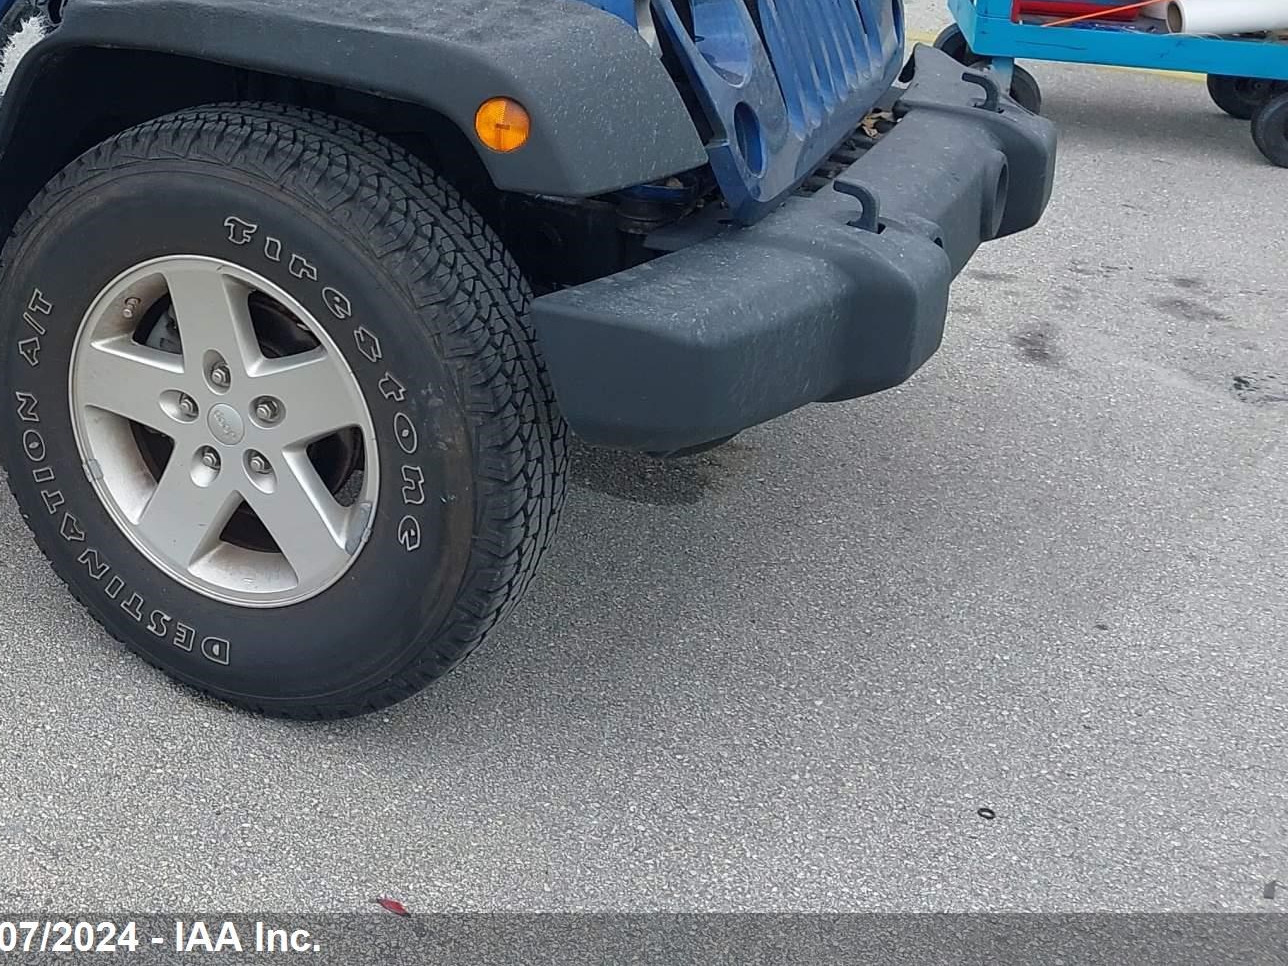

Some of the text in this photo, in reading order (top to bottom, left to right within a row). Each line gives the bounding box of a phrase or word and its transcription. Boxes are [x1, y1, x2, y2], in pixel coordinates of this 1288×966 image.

[17, 287, 231, 667] DESTINATION A/T
[223, 216, 426, 553] Firestone
